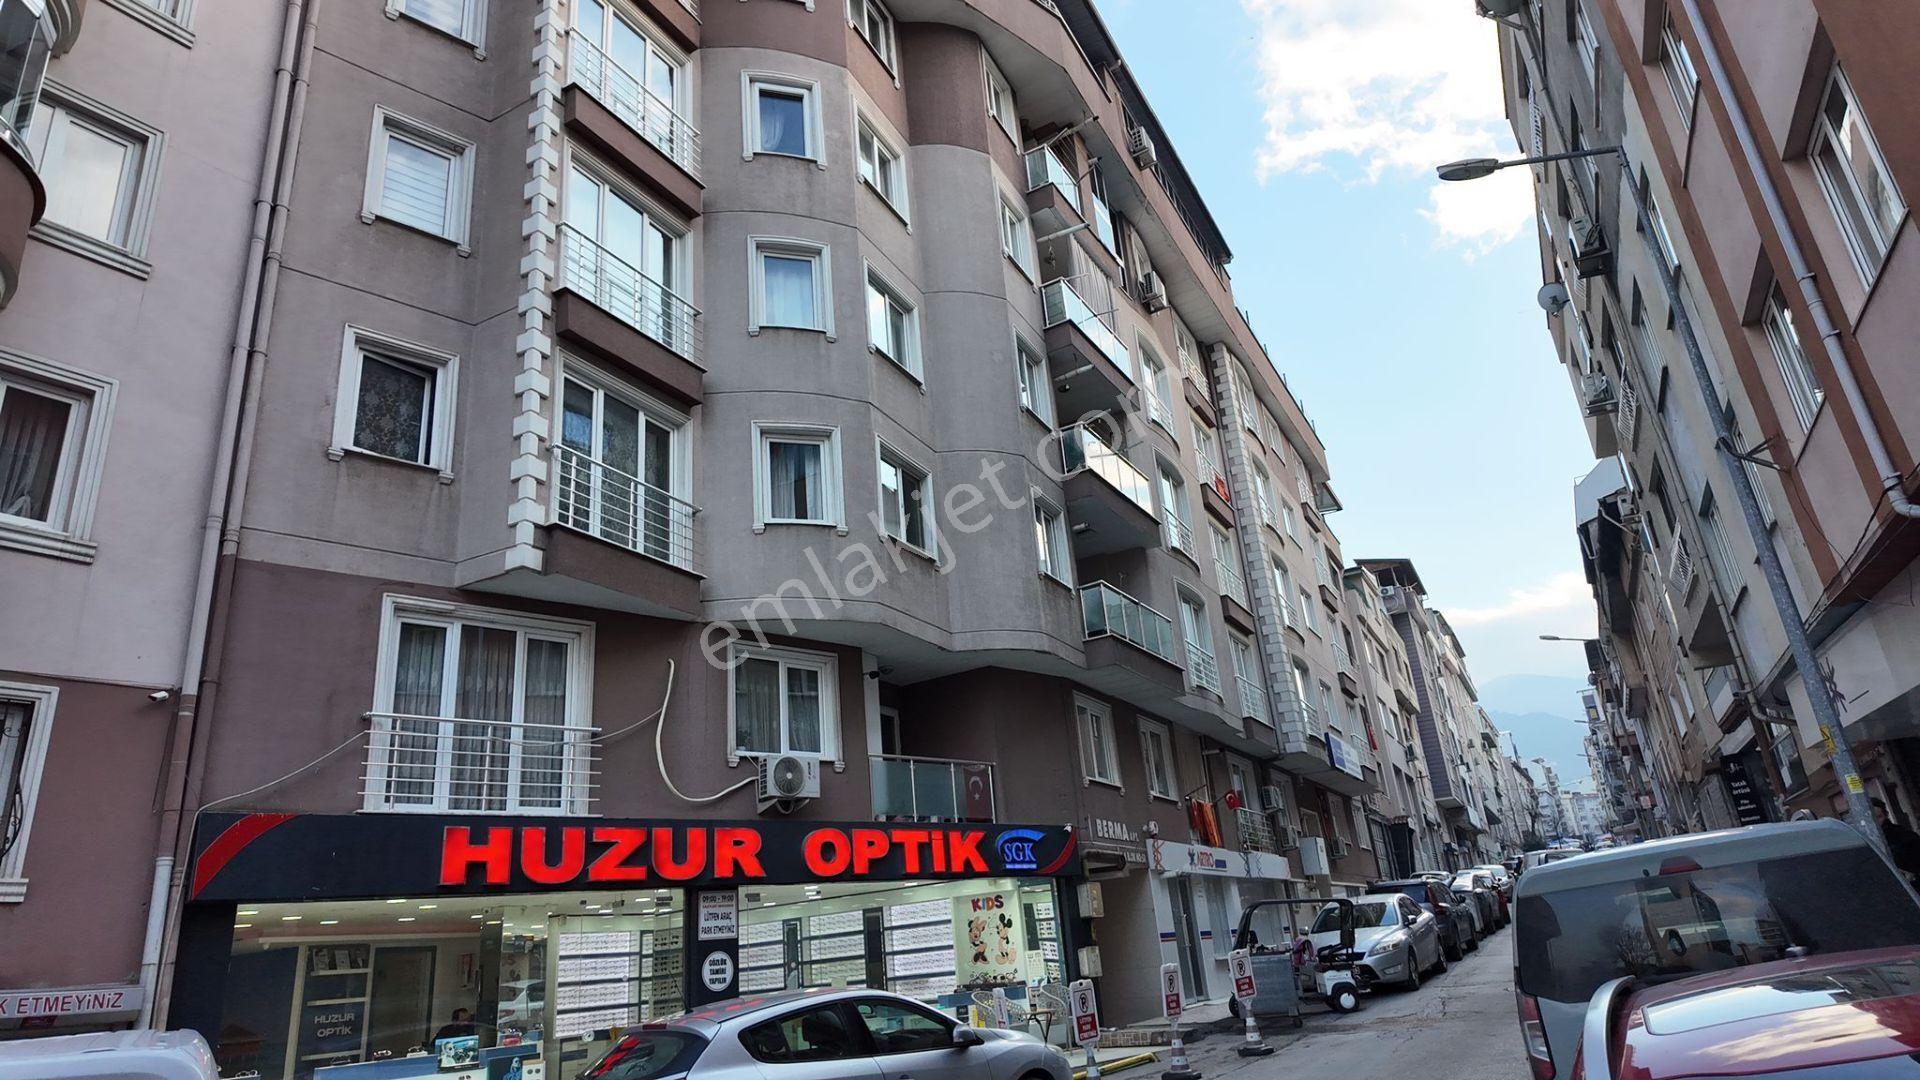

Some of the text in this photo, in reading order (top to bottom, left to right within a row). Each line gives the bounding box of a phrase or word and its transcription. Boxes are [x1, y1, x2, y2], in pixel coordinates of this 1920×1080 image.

[1096, 818, 1130, 841] BERMA
[439, 825, 767, 885] HUZUR
[1004, 841, 1037, 862] SGK
[971, 894, 1004, 912] KIDS
[313, 1012, 355, 1025] HUZUR
